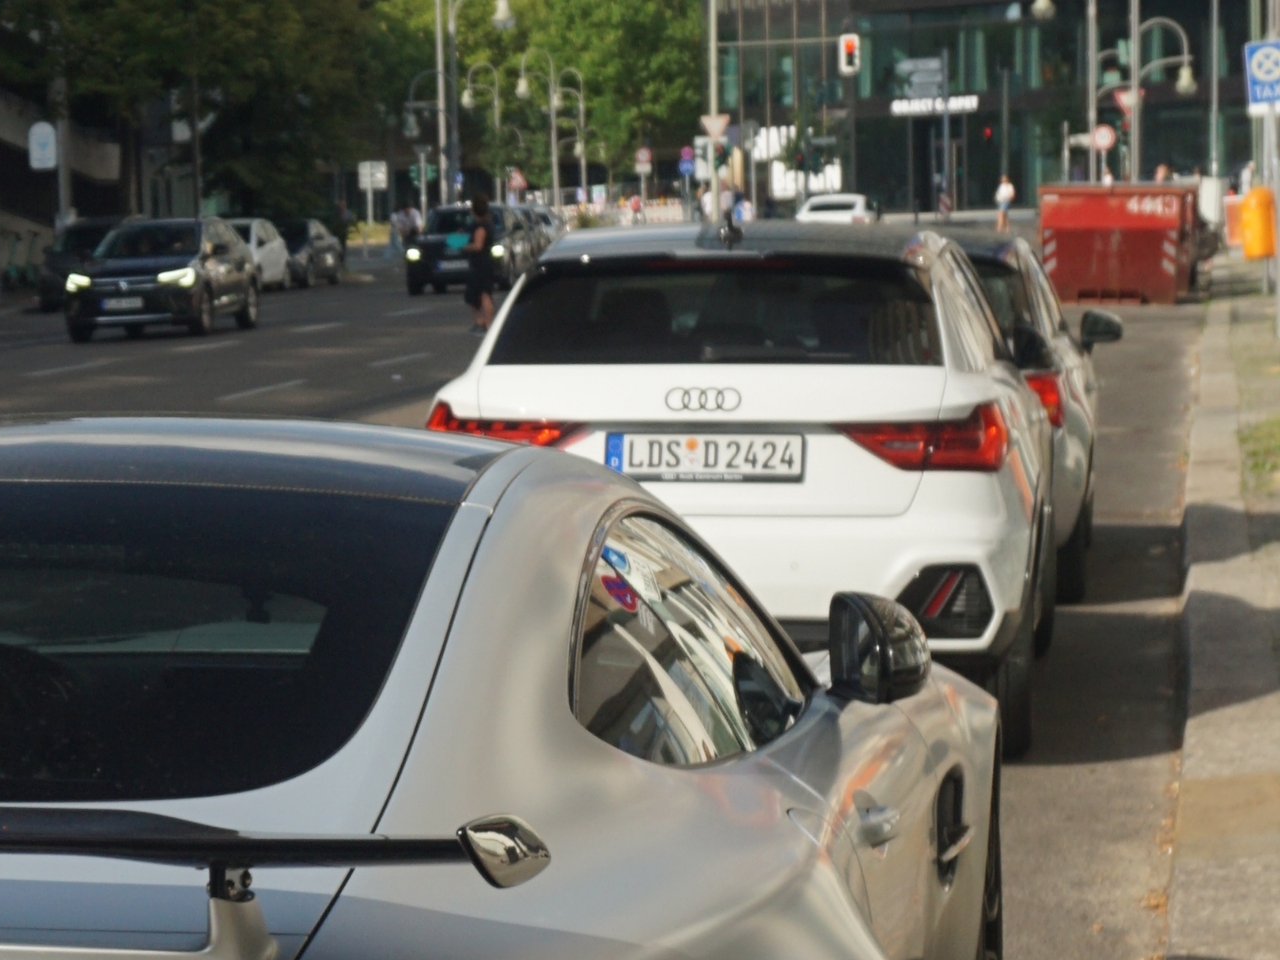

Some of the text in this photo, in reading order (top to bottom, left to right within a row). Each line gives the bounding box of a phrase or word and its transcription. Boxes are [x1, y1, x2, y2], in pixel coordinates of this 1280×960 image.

[628, 439, 681, 468] LDS
[702, 439, 719, 469] D
[725, 440, 794, 470] 2424
